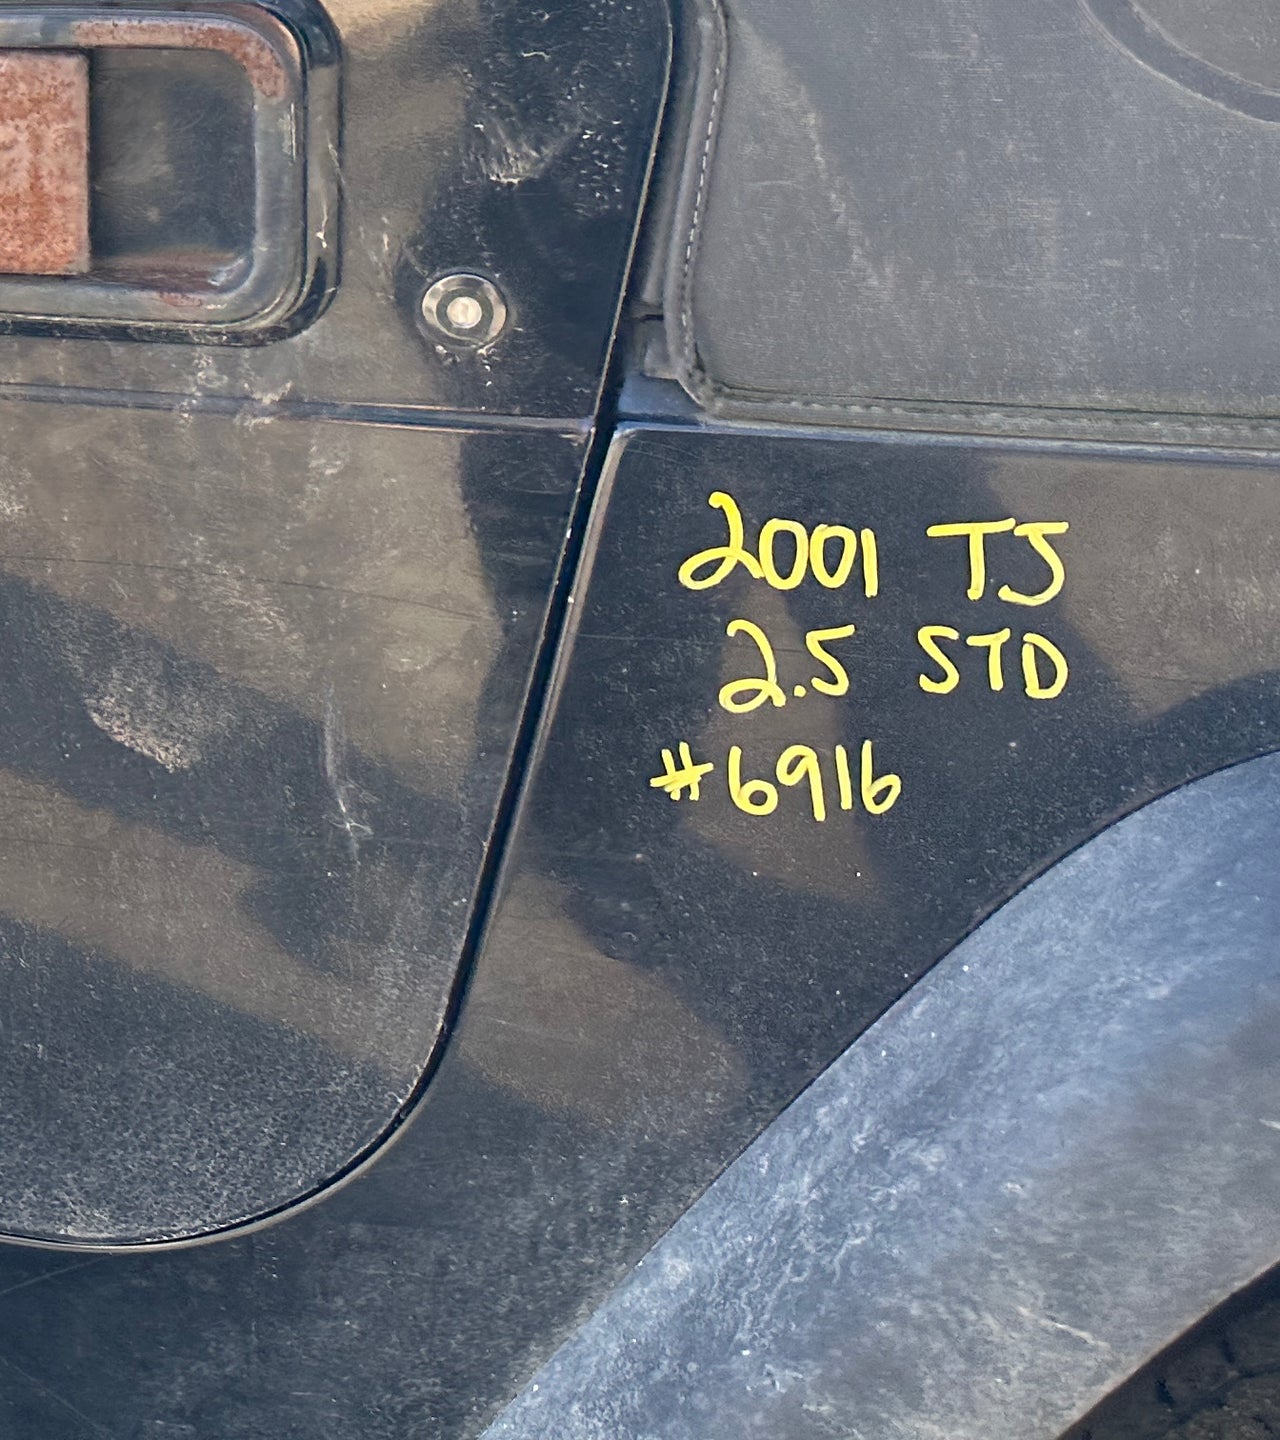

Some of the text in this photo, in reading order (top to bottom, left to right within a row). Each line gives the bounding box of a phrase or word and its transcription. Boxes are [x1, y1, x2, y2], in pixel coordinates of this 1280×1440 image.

[678, 491, 1069, 606] 2001 TJ
[718, 619, 1069, 713] 2.5 STD
[649, 739, 902, 822] #6916
